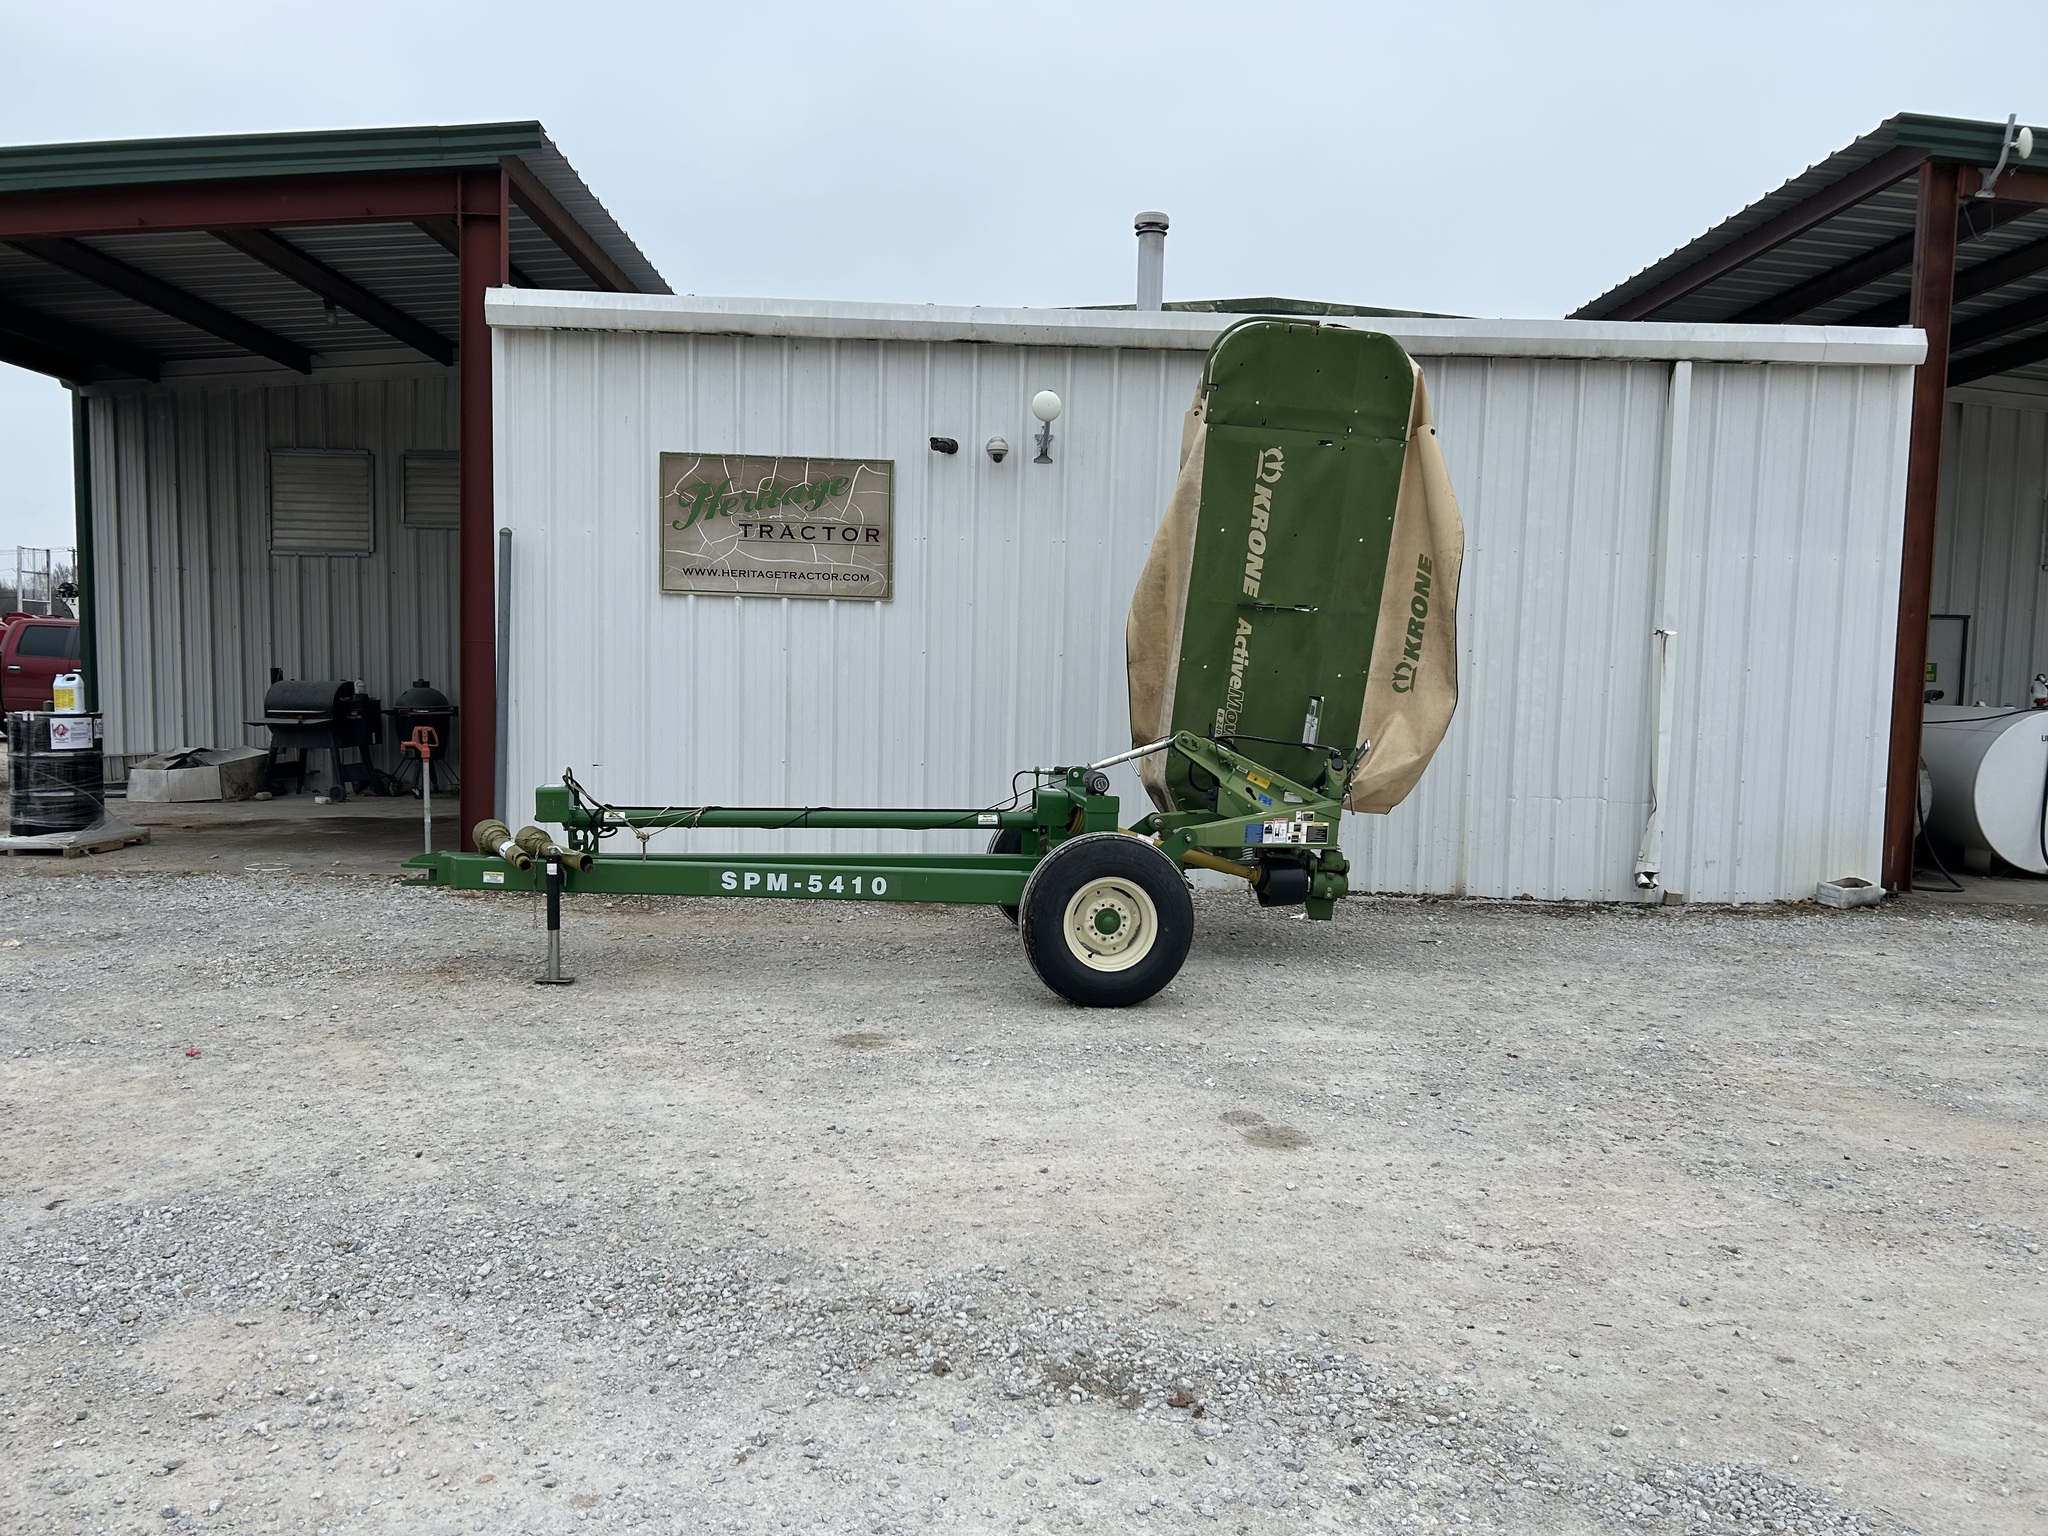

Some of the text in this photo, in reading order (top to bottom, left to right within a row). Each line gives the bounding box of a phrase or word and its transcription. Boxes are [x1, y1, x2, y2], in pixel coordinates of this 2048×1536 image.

[672, 476, 852, 530] Heritage
[738, 523, 880, 543] TRACTOR
[1243, 483, 1272, 598] KRONE
[682, 567, 870, 582] WWW.HERITAGETRACTOR.COM
[1403, 553, 1432, 662] KRONE
[1215, 720, 1223, 735] 240
[721, 871, 887, 895] SPM-5410
